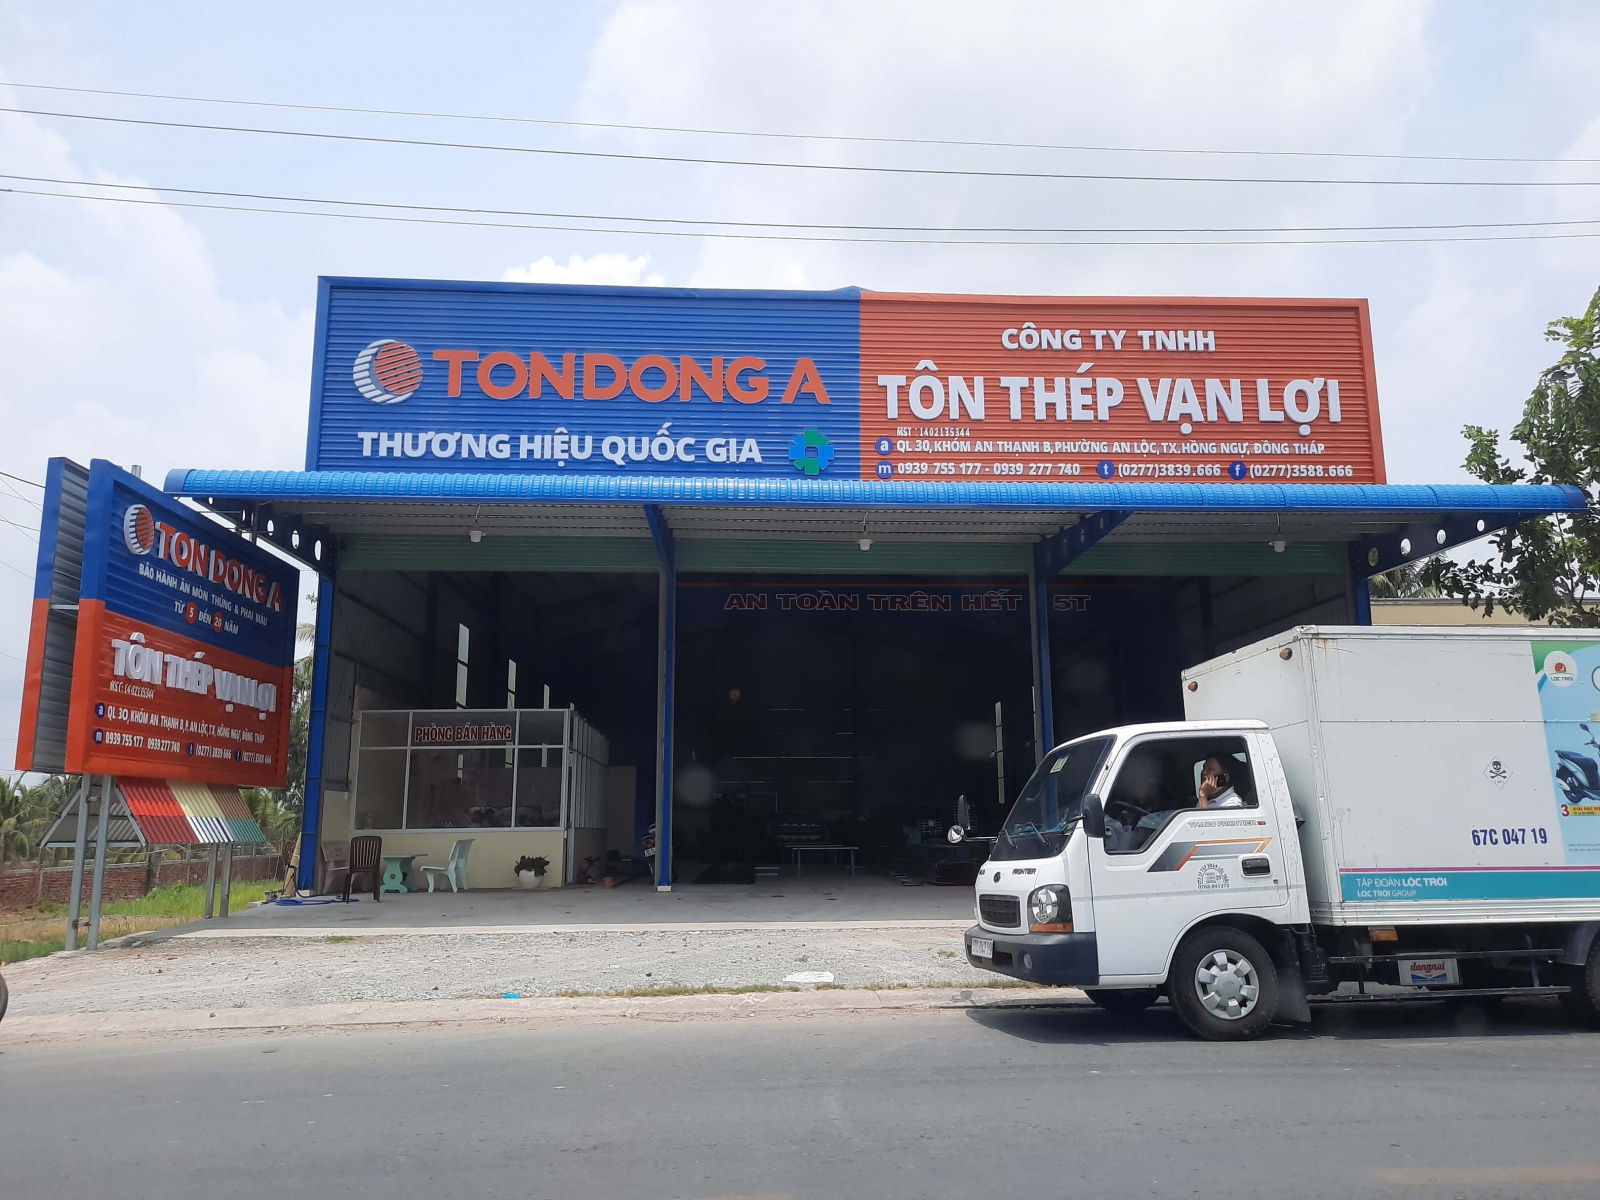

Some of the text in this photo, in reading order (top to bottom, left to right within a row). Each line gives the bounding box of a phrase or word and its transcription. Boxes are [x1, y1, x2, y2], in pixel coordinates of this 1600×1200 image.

[1001, 321, 1216, 352] CÔNG TY TNHH
[781, 357, 831, 404] A
[877, 359, 1342, 437] TÔN THÉP VẠN LỢI
[897, 427, 912, 437] MST
[357, 422, 763, 467] THƯƠNG HIỆU QUỐC GIA
[935, 437, 971, 452] KHÓM
[975, 441, 993, 452] AN
[997, 441, 1040, 457] THẠNH
[1112, 442, 1131, 453] AN
[1253, 439, 1290, 454] ĐỒNG
[1293, 440, 1325, 454] THÁP
[897, 462, 928, 475] 0939
[933, 462, 957, 475] 755
[959, 463, 982, 475] 177
[993, 463, 1024, 475] 0939
[1028, 463, 1053, 475] 277
[1057, 463, 1081, 475] 740
[139, 562, 154, 579] BẢO
[156, 568, 178, 589] HÀNH
[180, 578, 191, 594] ĂN
[192, 585, 209, 601] MÒN
[234, 604, 239, 615] &
[266, 581, 282, 612] A
[724, 593, 768, 610] AN
[776, 589, 859, 611] TOÀN
[867, 590, 952, 611] TRÊN
[961, 588, 1022, 611] HẾT
[174, 600, 239, 635] TỪ 5 ĐẾN 20 NĂM
[111, 632, 164, 685] TÔN
[164, 651, 214, 695] THÉP
[150, 713, 159, 726] AN
[106, 731, 121, 745] 0939
[121, 734, 132, 747] 755
[133, 736, 144, 748] 177
[147, 737, 160, 750] 0939
[160, 739, 171, 752] 277
[415, 721, 512, 742] PHÒNG BÁN HÀNG
[1560, 803, 1570, 818] 3
[1471, 828, 1548, 846] 67C 047 19
[1356, 876, 1448, 889] TẬP ĐOÀN LỘC TRỜI
[1391, 889, 1417, 897] GROUP
